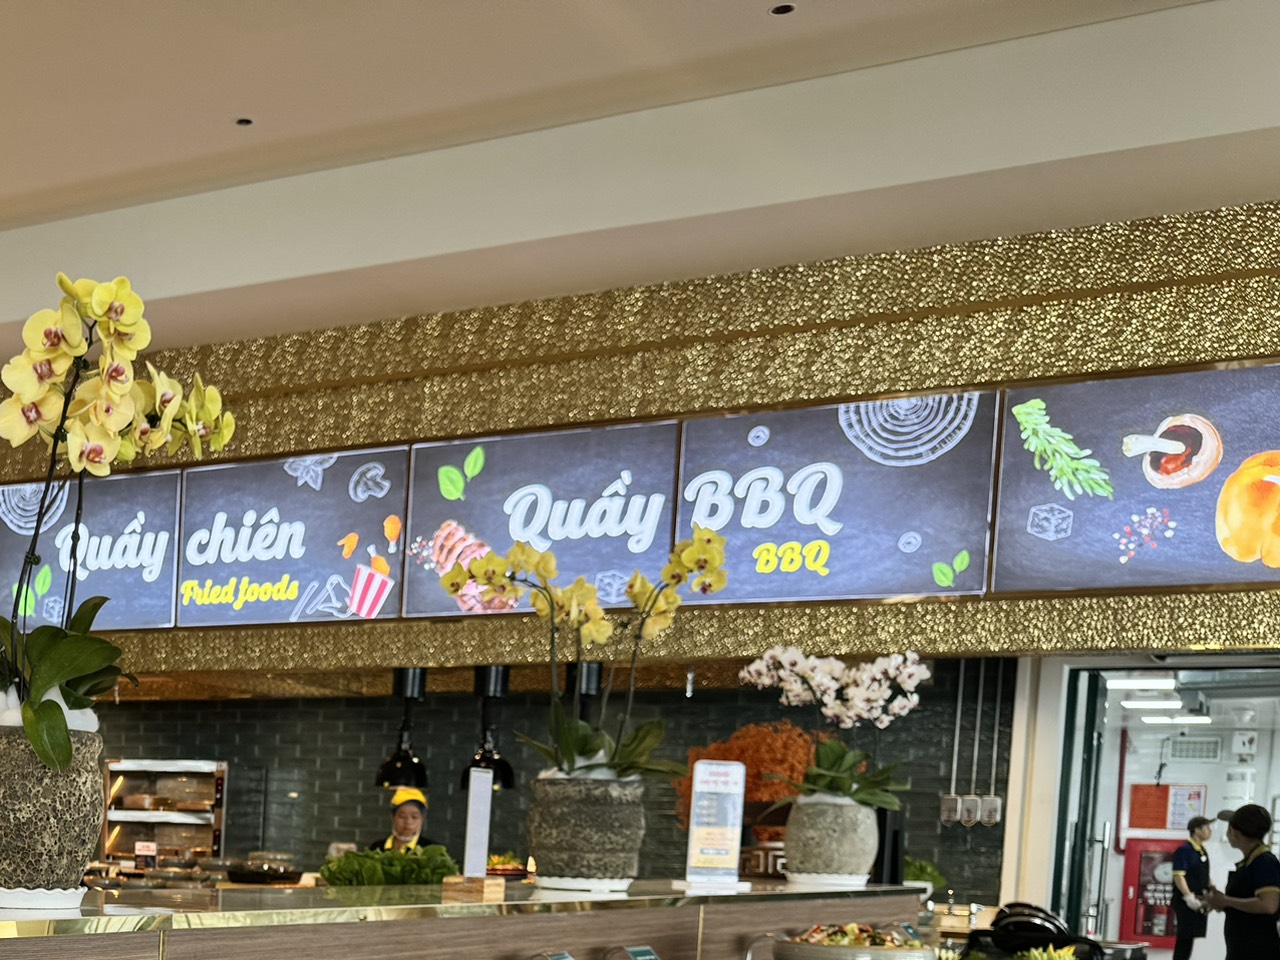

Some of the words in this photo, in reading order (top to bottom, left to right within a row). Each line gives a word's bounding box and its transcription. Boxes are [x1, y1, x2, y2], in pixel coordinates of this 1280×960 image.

[503, 469, 666, 553] Quầy
[683, 462, 844, 536] BBQ
[54, 510, 169, 582] Quầy
[185, 507, 306, 566] chiên
[752, 540, 830, 576] BBQ
[180, 576, 238, 606] Fried
[232, 573, 299, 610] foods
